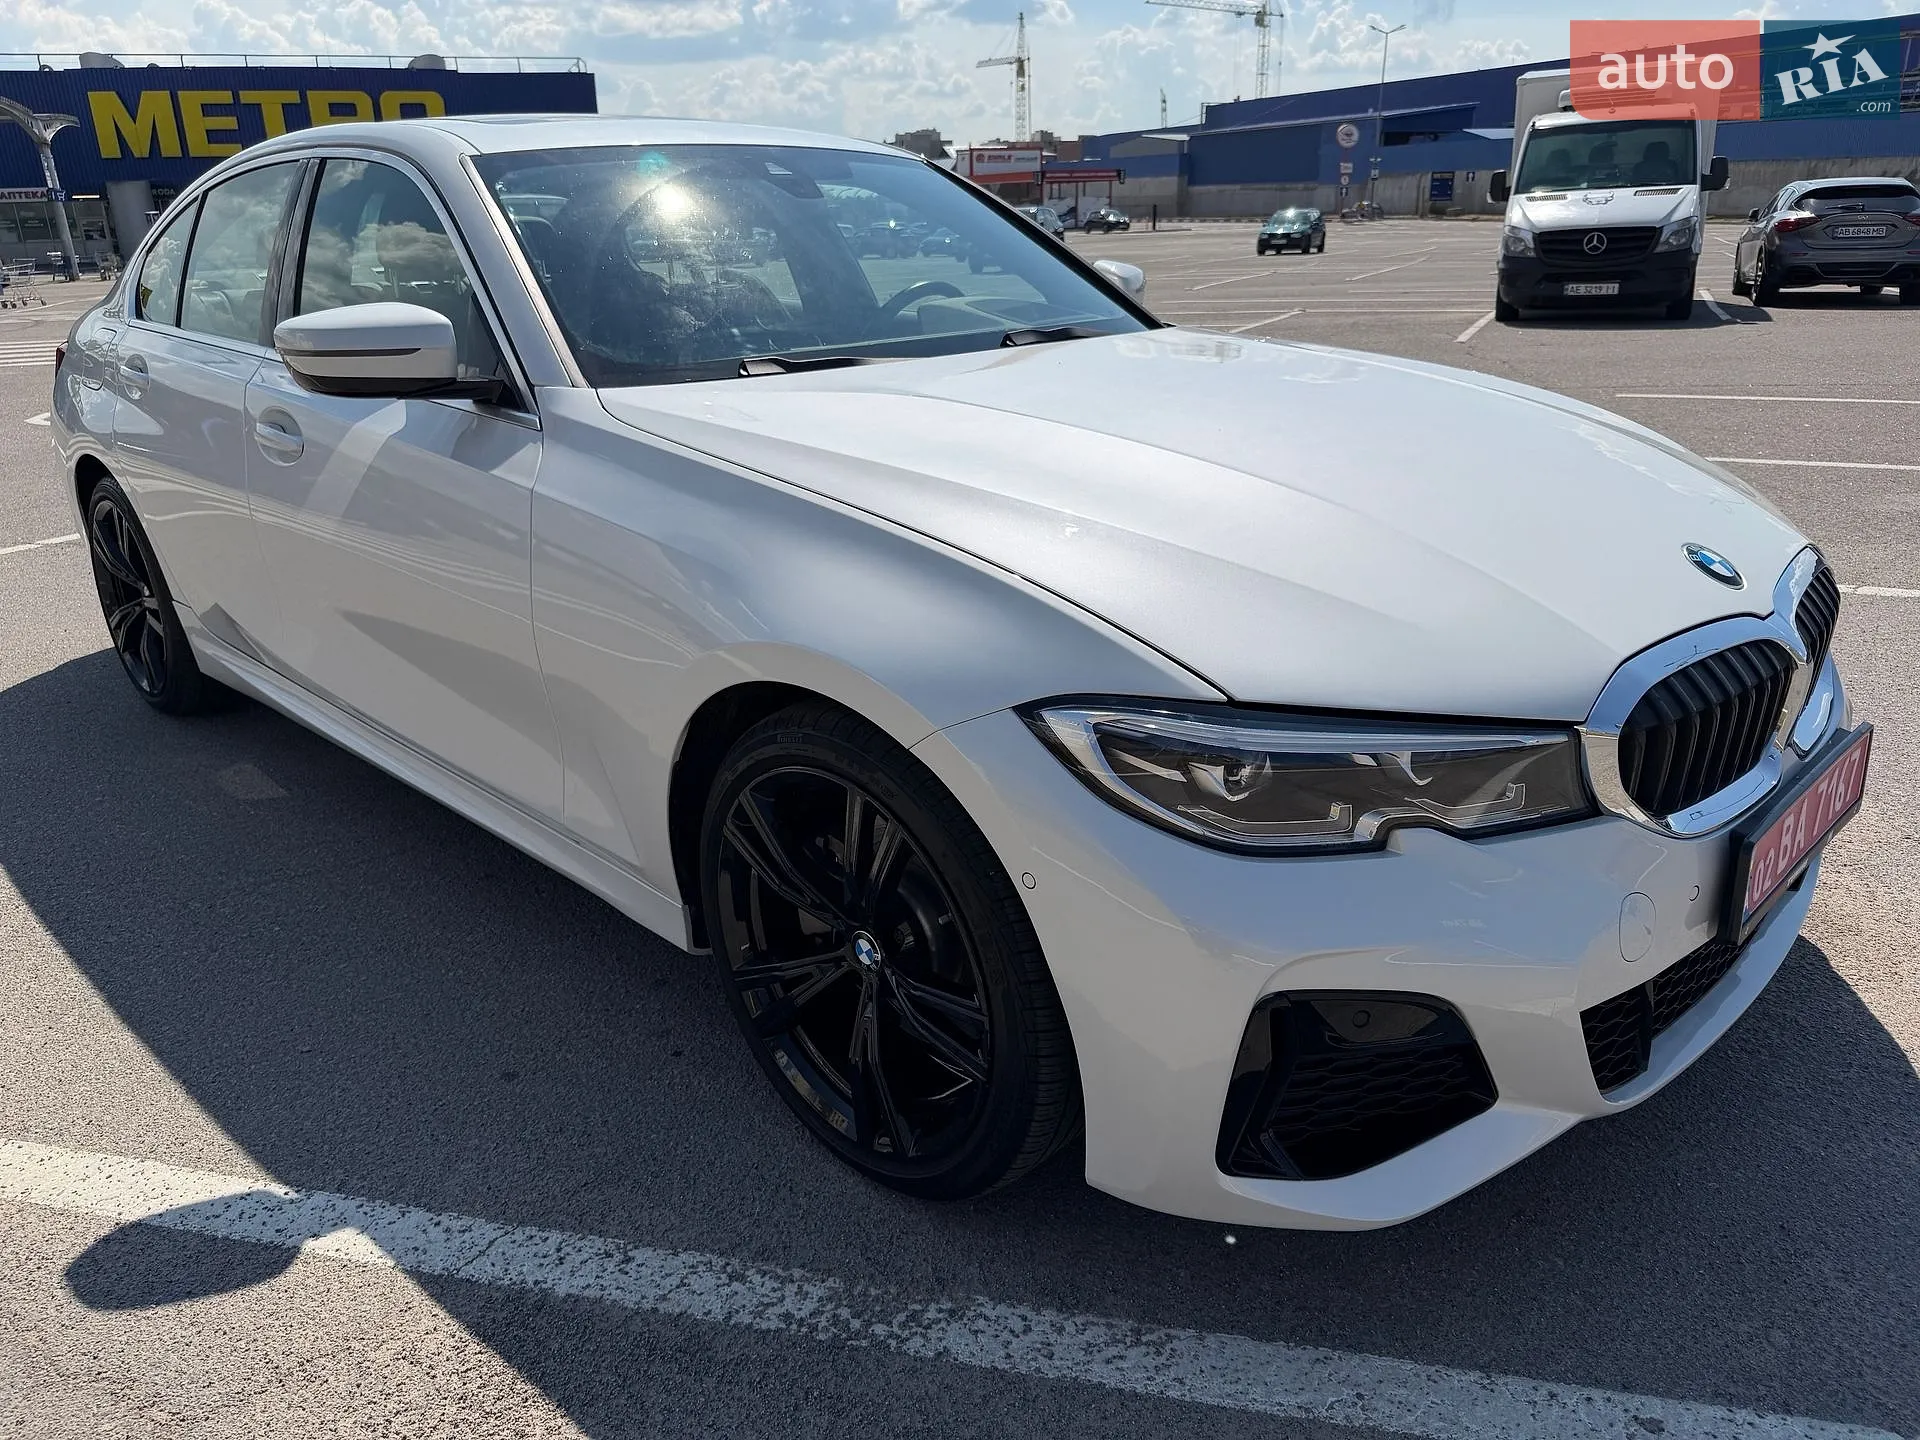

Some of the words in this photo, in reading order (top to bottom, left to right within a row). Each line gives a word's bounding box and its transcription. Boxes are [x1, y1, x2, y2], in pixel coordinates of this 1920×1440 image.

[0, 190, 48, 200] АПТЕКА
[1753, 847, 1775, 898] 02
[1777, 798, 1808, 875] BA
[1812, 746, 1862, 837] 7167
